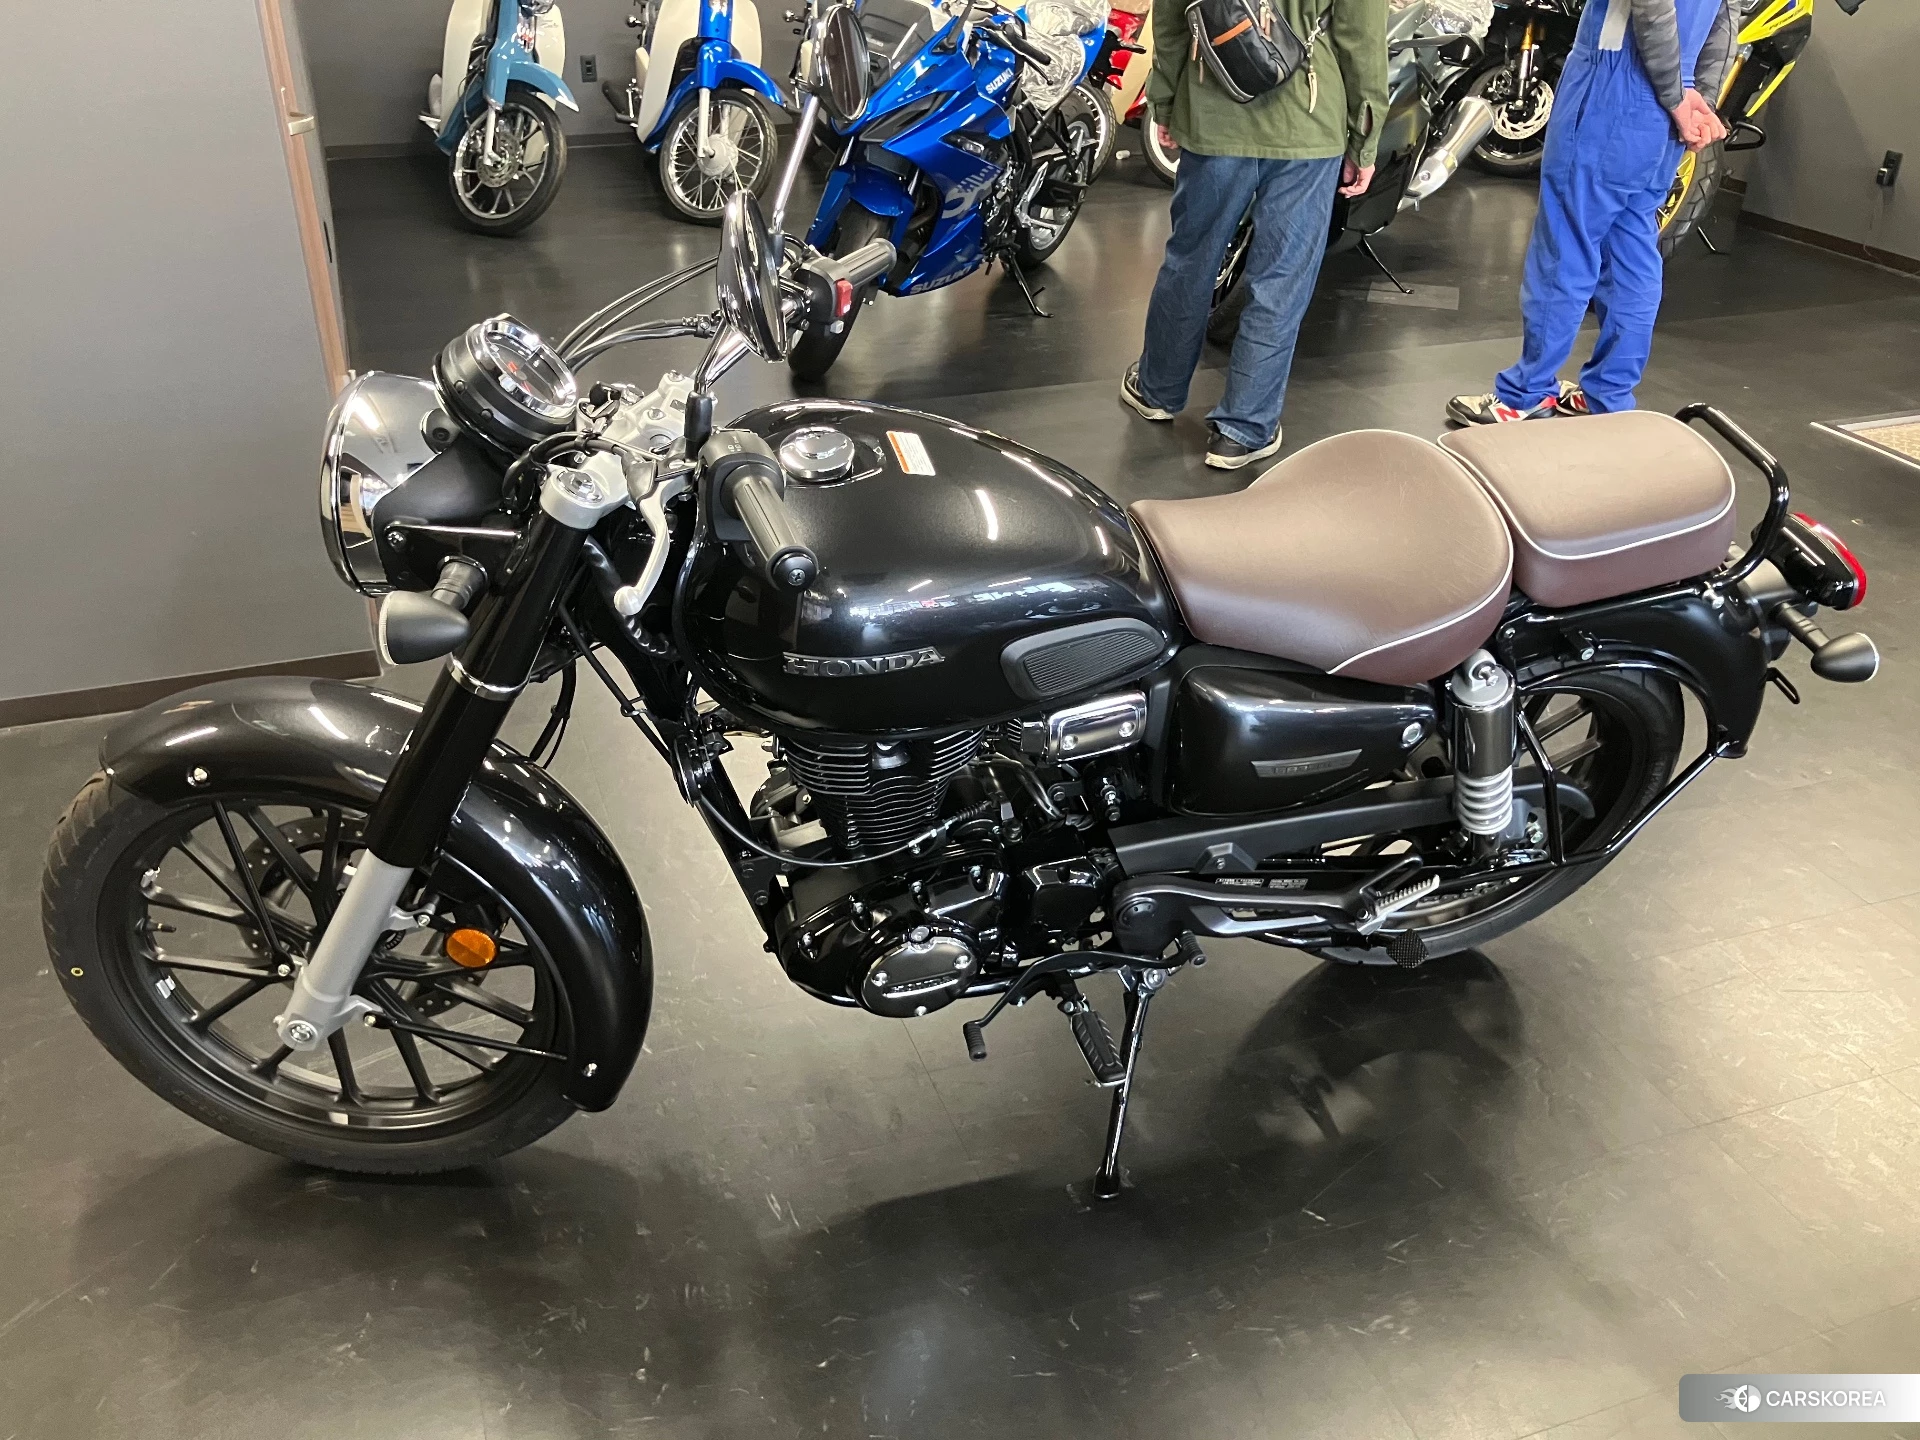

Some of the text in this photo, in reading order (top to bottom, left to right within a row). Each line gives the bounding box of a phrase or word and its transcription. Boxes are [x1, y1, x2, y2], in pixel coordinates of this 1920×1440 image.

[985, 67, 1014, 95] SUZUKI
[909, 264, 973, 294] SUZUKI
[783, 648, 946, 677] HONDA
